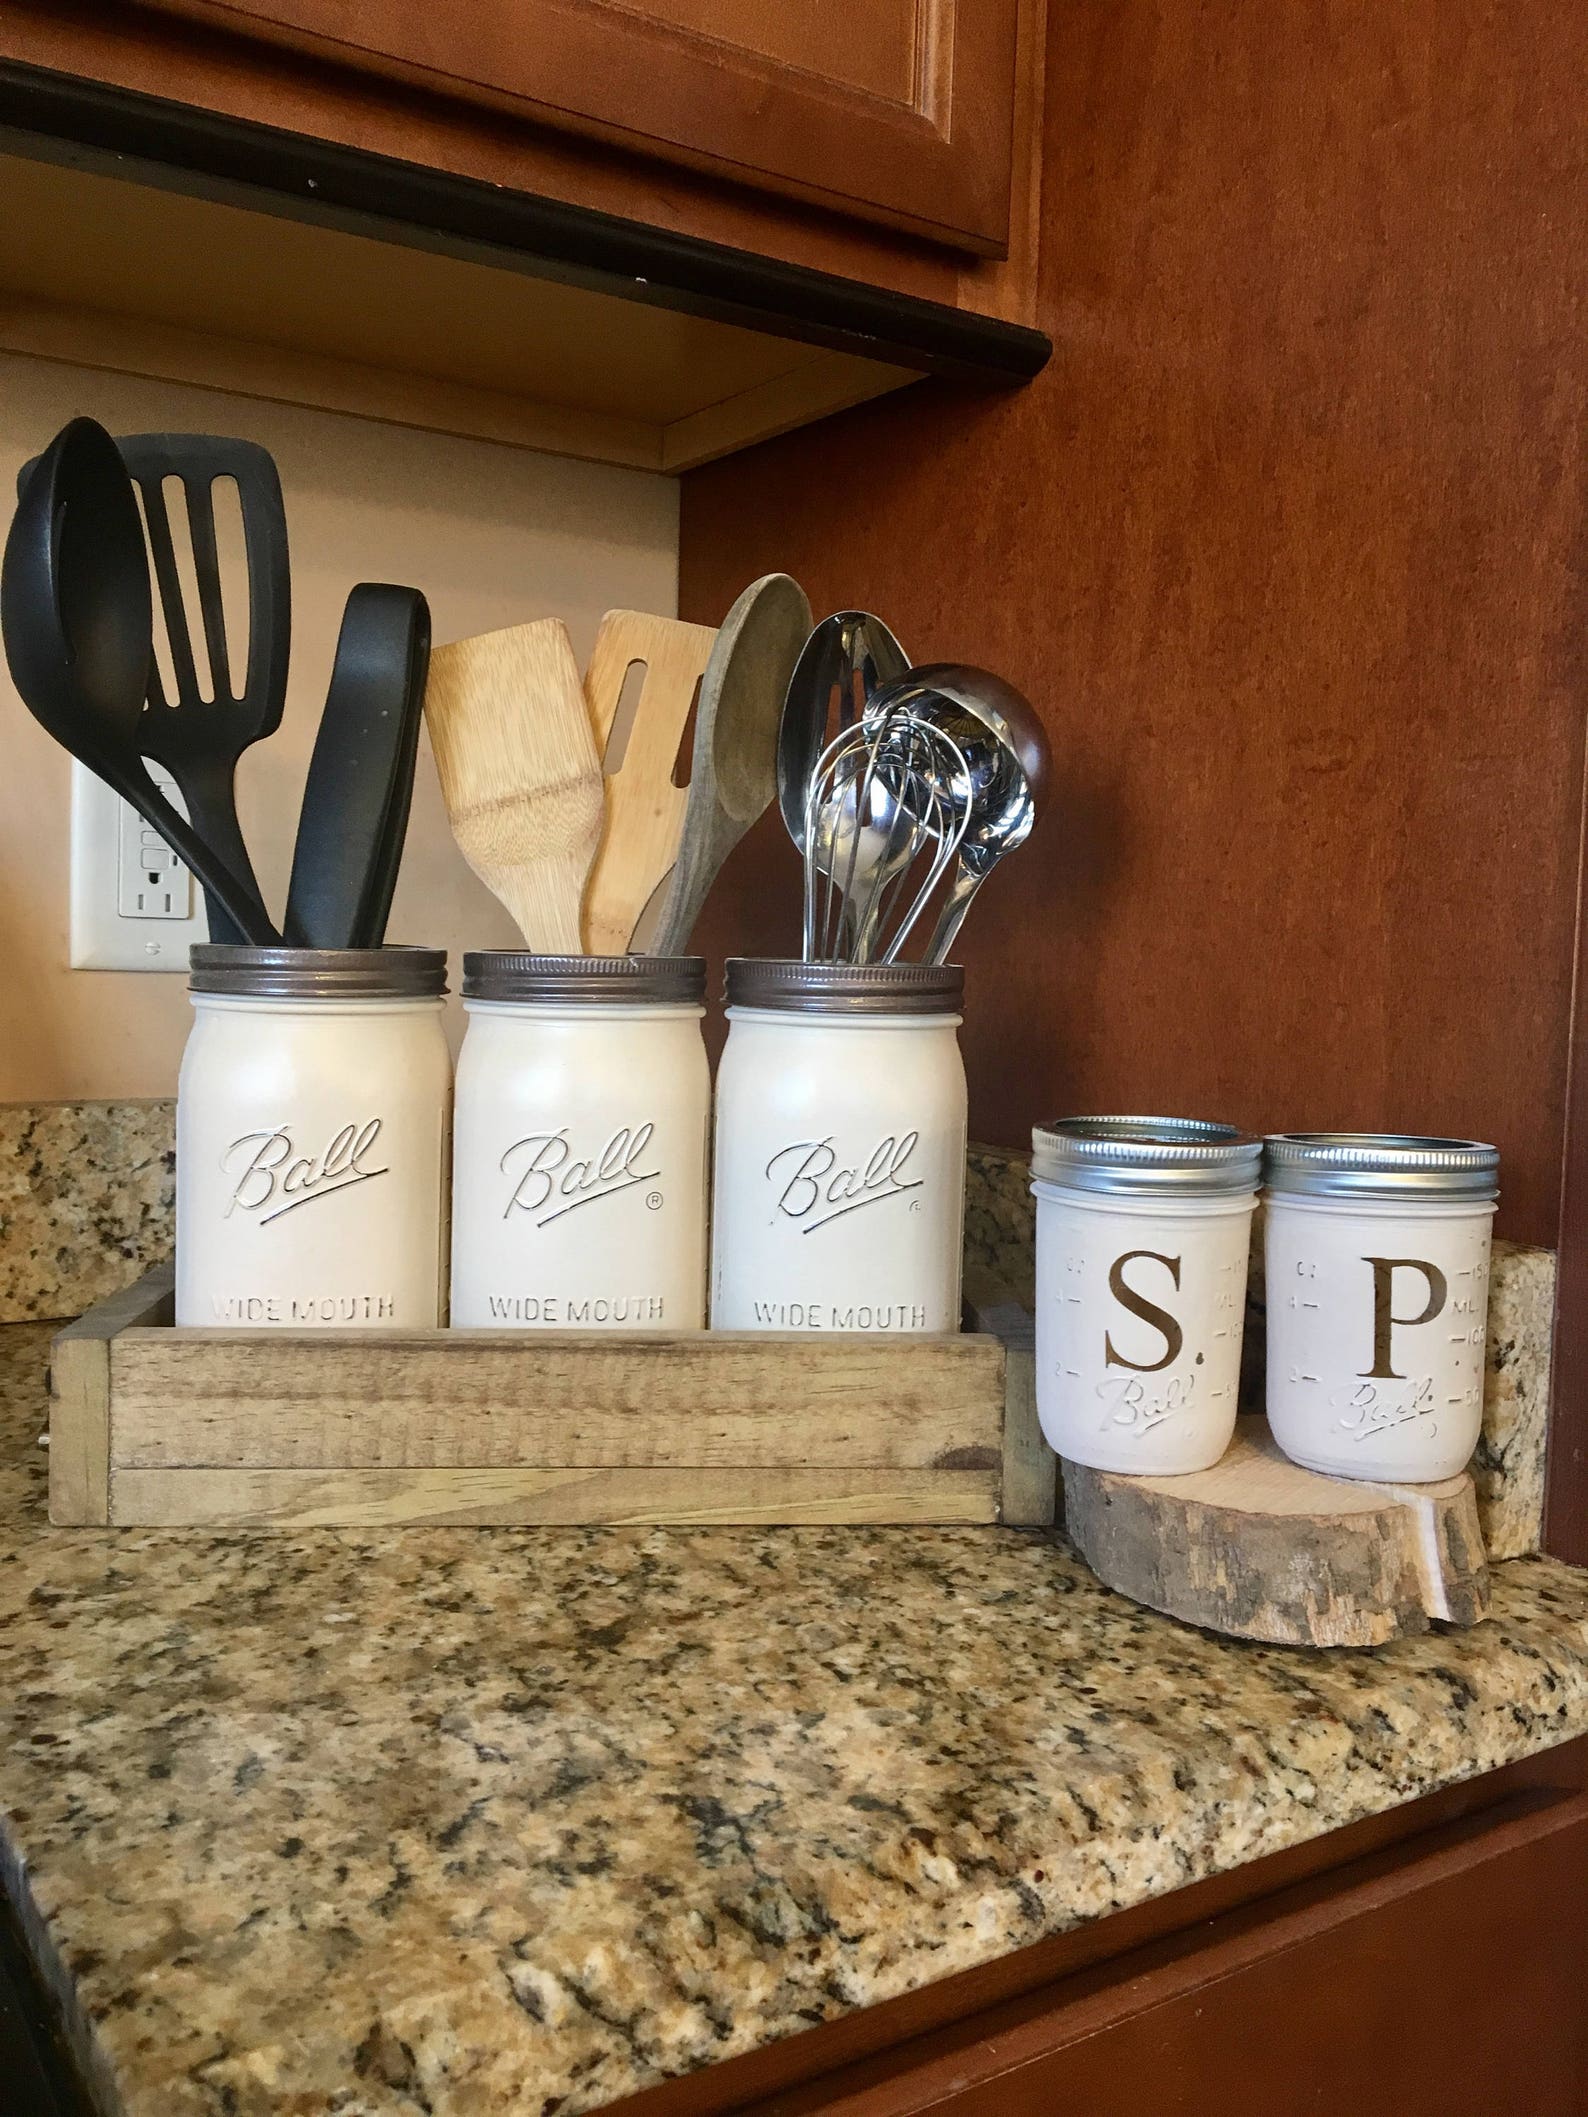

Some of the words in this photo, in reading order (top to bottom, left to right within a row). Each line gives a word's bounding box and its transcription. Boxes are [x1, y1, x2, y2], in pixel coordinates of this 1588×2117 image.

[220, 1118, 388, 1225] Ball
[499, 1122, 661, 1228] Ball
[765, 1131, 924, 1235] Ball
[211, 1295, 281, 1321] WIDE
[292, 1297, 394, 1321] MOUTH
[489, 1296, 558, 1321] WIDE
[566, 1298, 664, 1322] MOUTH
[754, 1302, 822, 1328] WIDE
[832, 1306, 926, 1329] MOUTH
[1105, 1250, 1183, 1373] S
[1356, 1257, 1448, 1379] P
